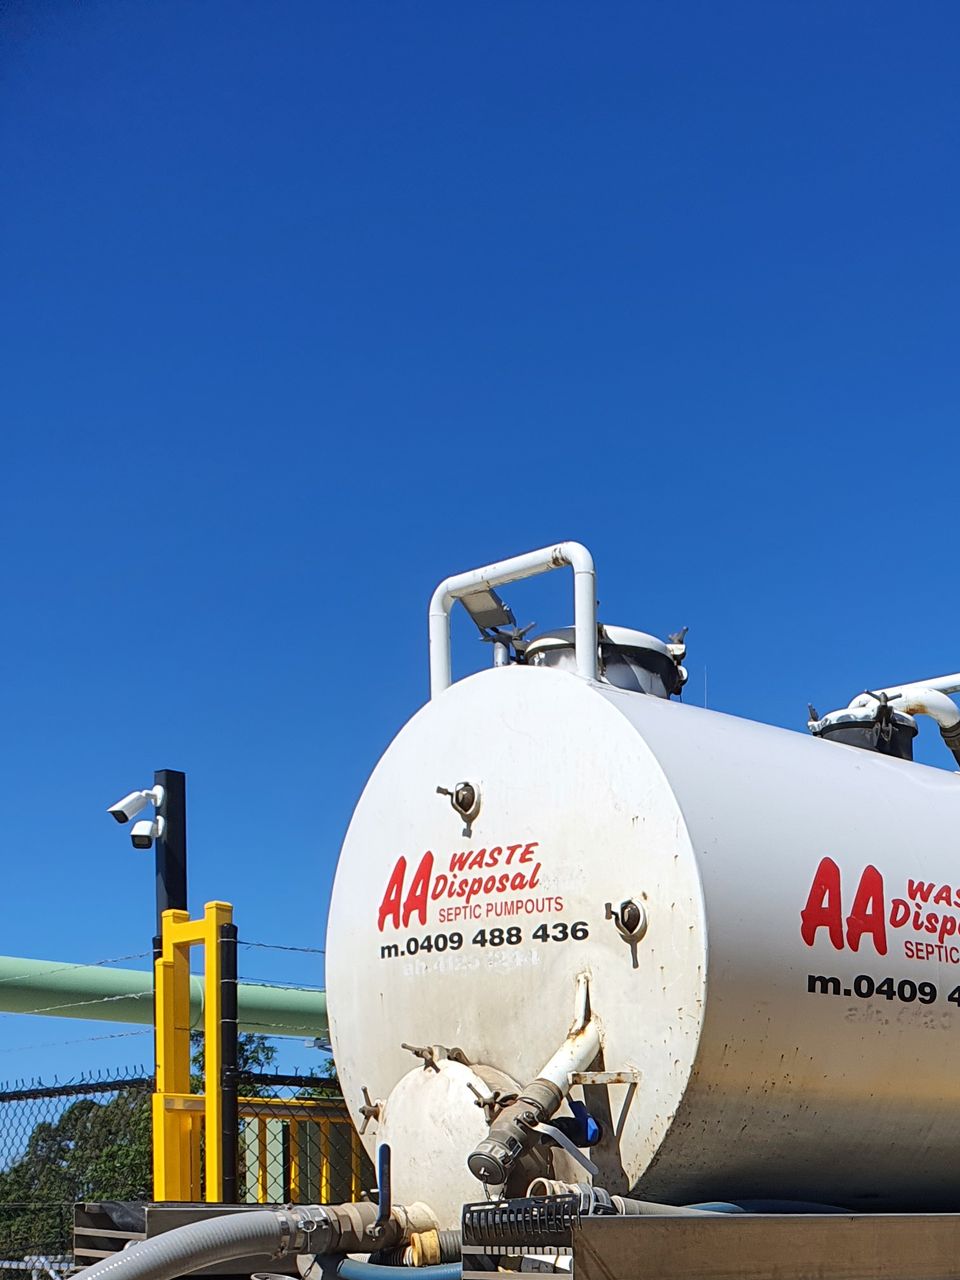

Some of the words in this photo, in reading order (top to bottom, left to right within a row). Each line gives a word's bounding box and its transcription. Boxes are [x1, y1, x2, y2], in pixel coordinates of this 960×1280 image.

[378, 850, 434, 932] AA
[449, 842, 539, 873] WASTE
[430, 862, 542, 904] Disposal
[438, 903, 482, 923] SEPTIC
[486, 896, 564, 917] PUMPOUTS
[801, 856, 888, 956] AA
[380, 932, 464, 959] m.0409
[472, 926, 522, 948] 488
[532, 921, 589, 943] 436
[904, 940, 960, 965] SEPTIC
[807, 974, 938, 1005] m.0409
